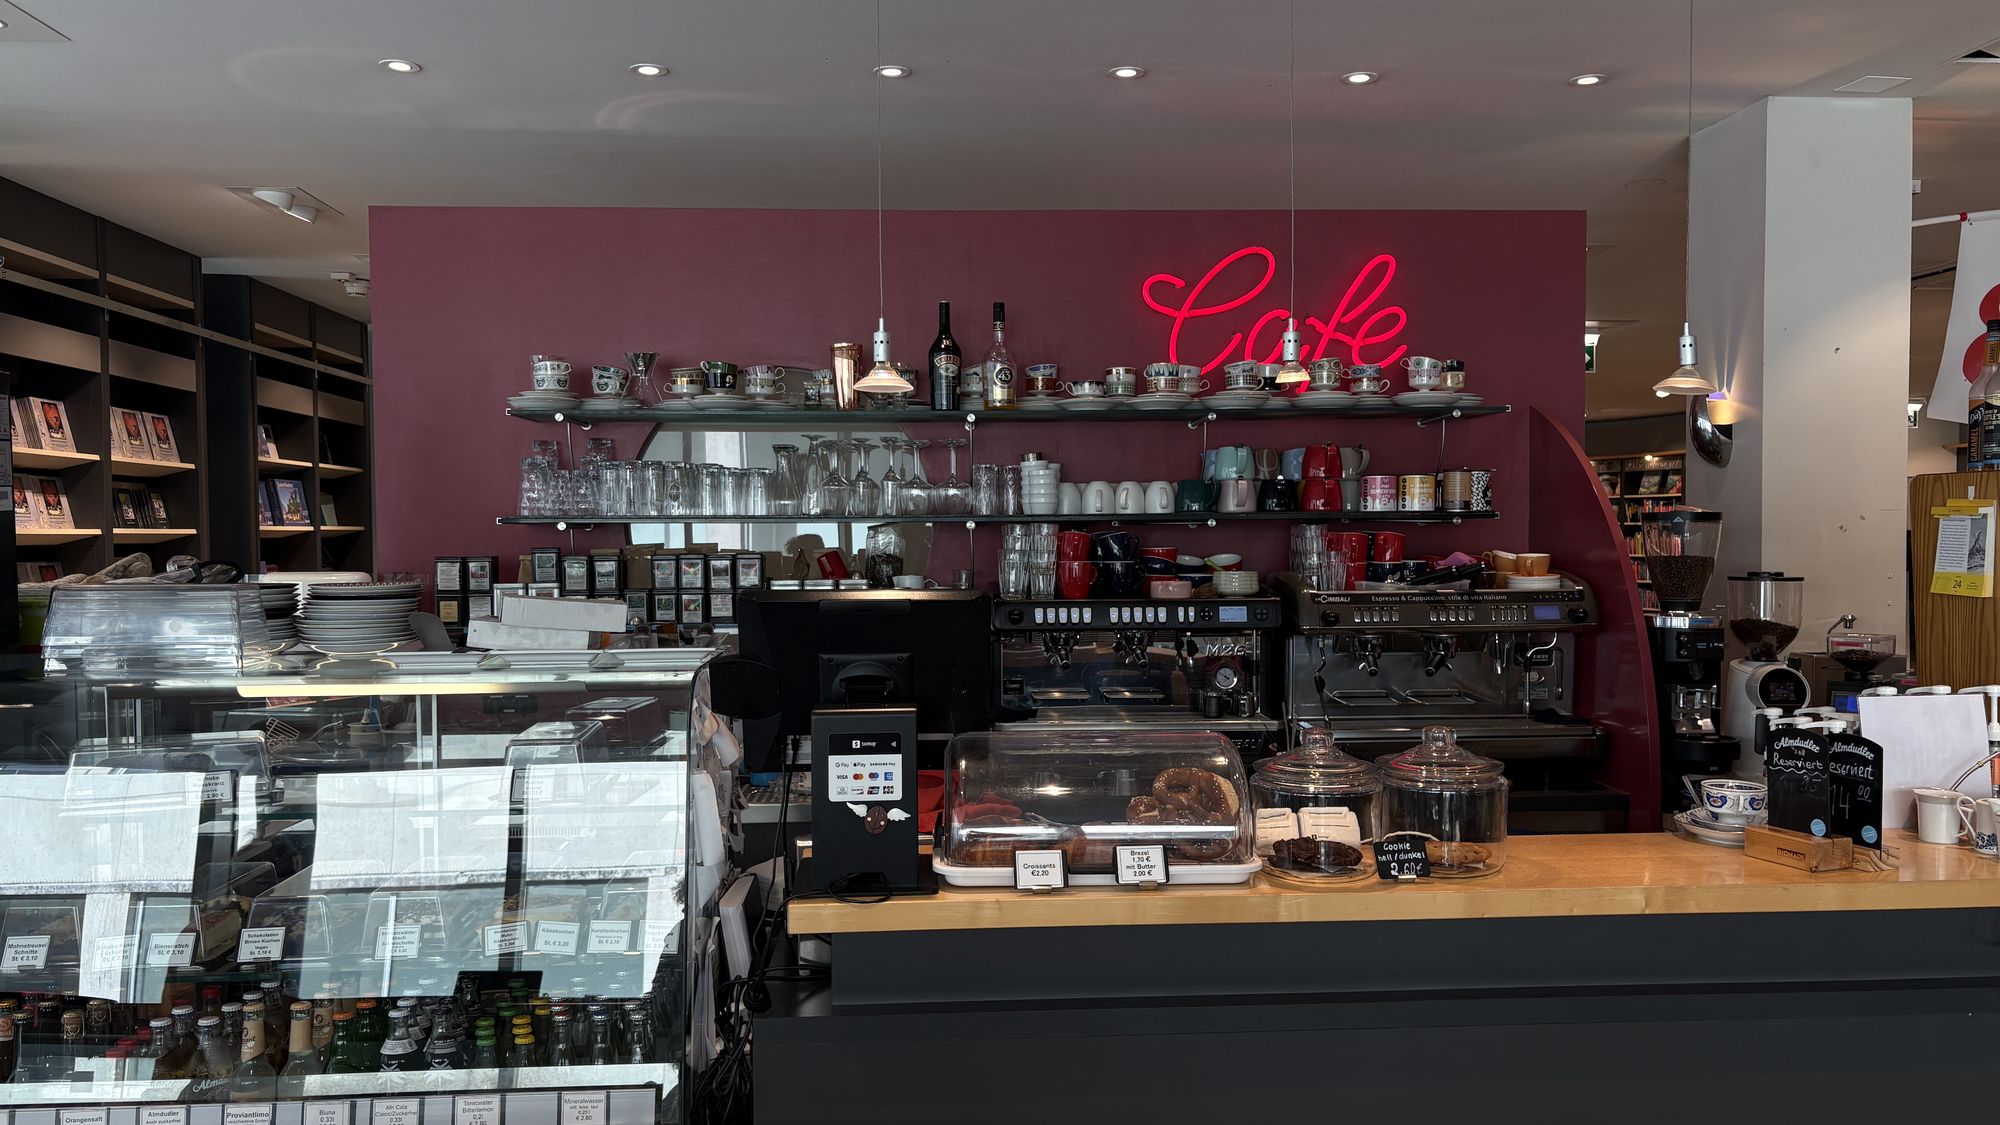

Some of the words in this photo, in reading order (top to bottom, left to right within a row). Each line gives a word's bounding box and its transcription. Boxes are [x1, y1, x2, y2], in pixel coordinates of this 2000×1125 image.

[998, 370, 1011, 381] 43
[1970, 427, 1979, 461] CARAMEL
[1953, 580, 1962, 589] 24
[1774, 737, 1821, 753] Almdudler
[1829, 741, 1875, 760] Almdudler
[1773, 752, 1824, 770] Reserviert
[1829, 762, 1875, 780] eserviert
[1383, 842, 1411, 851] Cookie
[65, 1117, 103, 1125] Orangensaft
[226, 1111, 270, 1119] Proviantlimo
